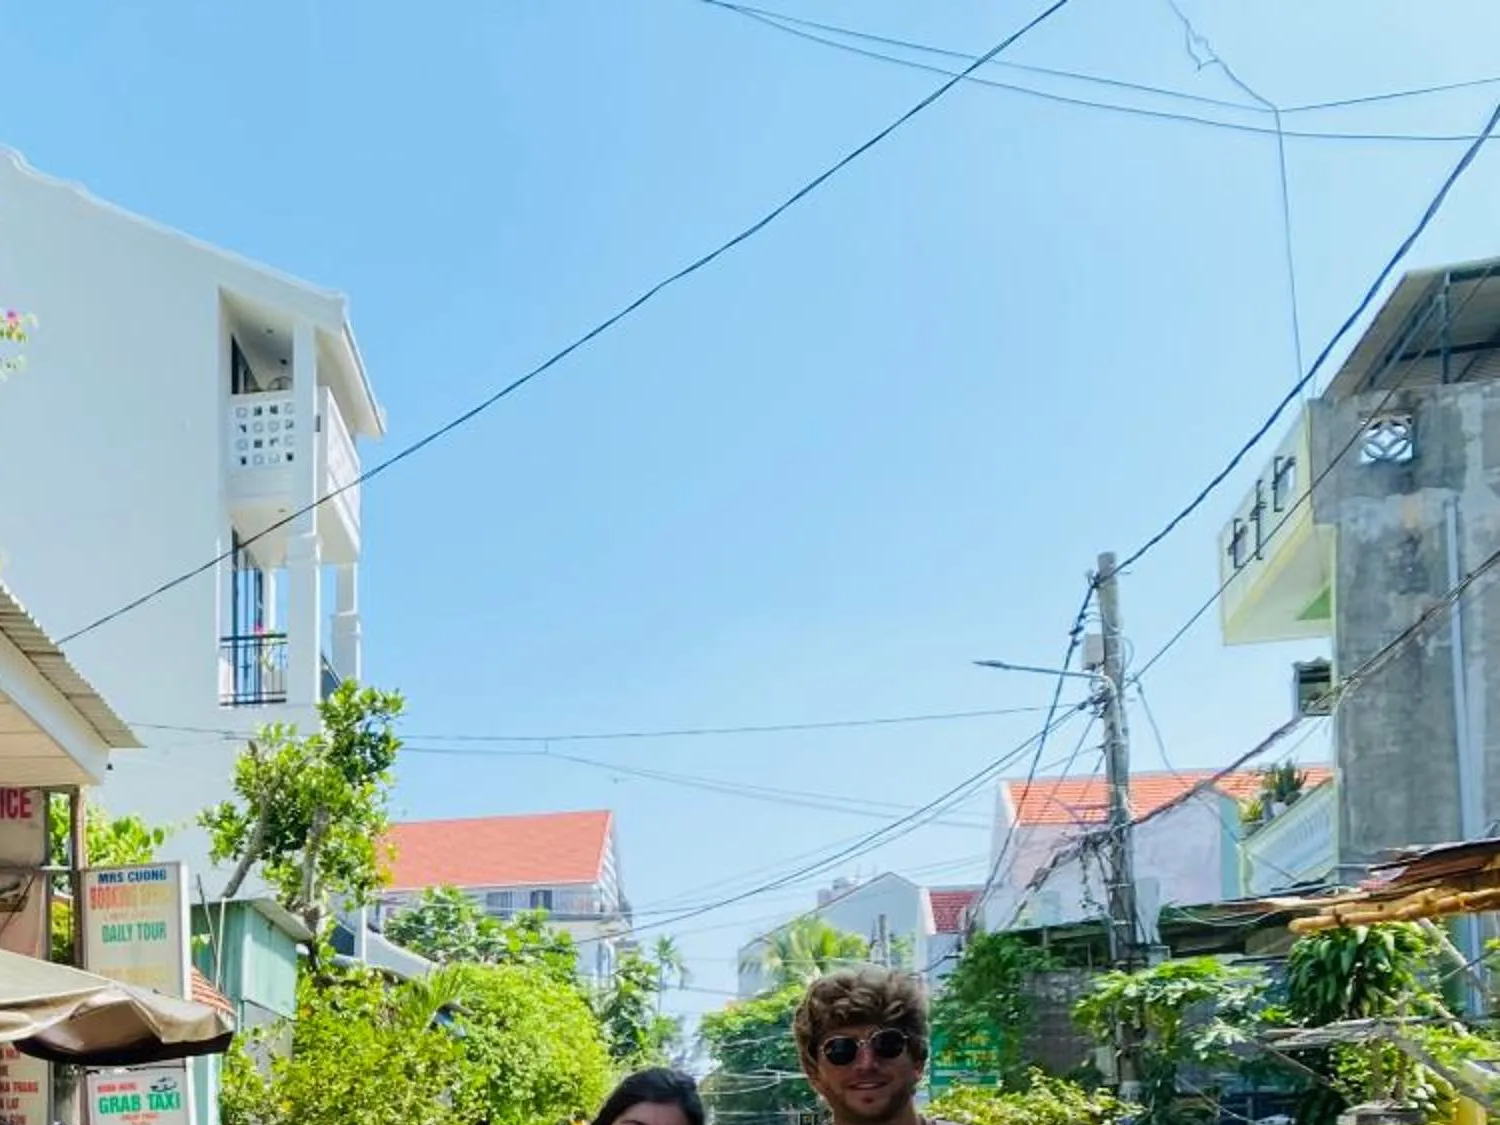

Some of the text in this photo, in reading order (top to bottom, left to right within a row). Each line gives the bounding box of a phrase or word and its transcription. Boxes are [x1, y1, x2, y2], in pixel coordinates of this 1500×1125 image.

[102, 922, 166, 943] DAILY TOUR
[99, 1091, 181, 1115] GRAB TAXI
